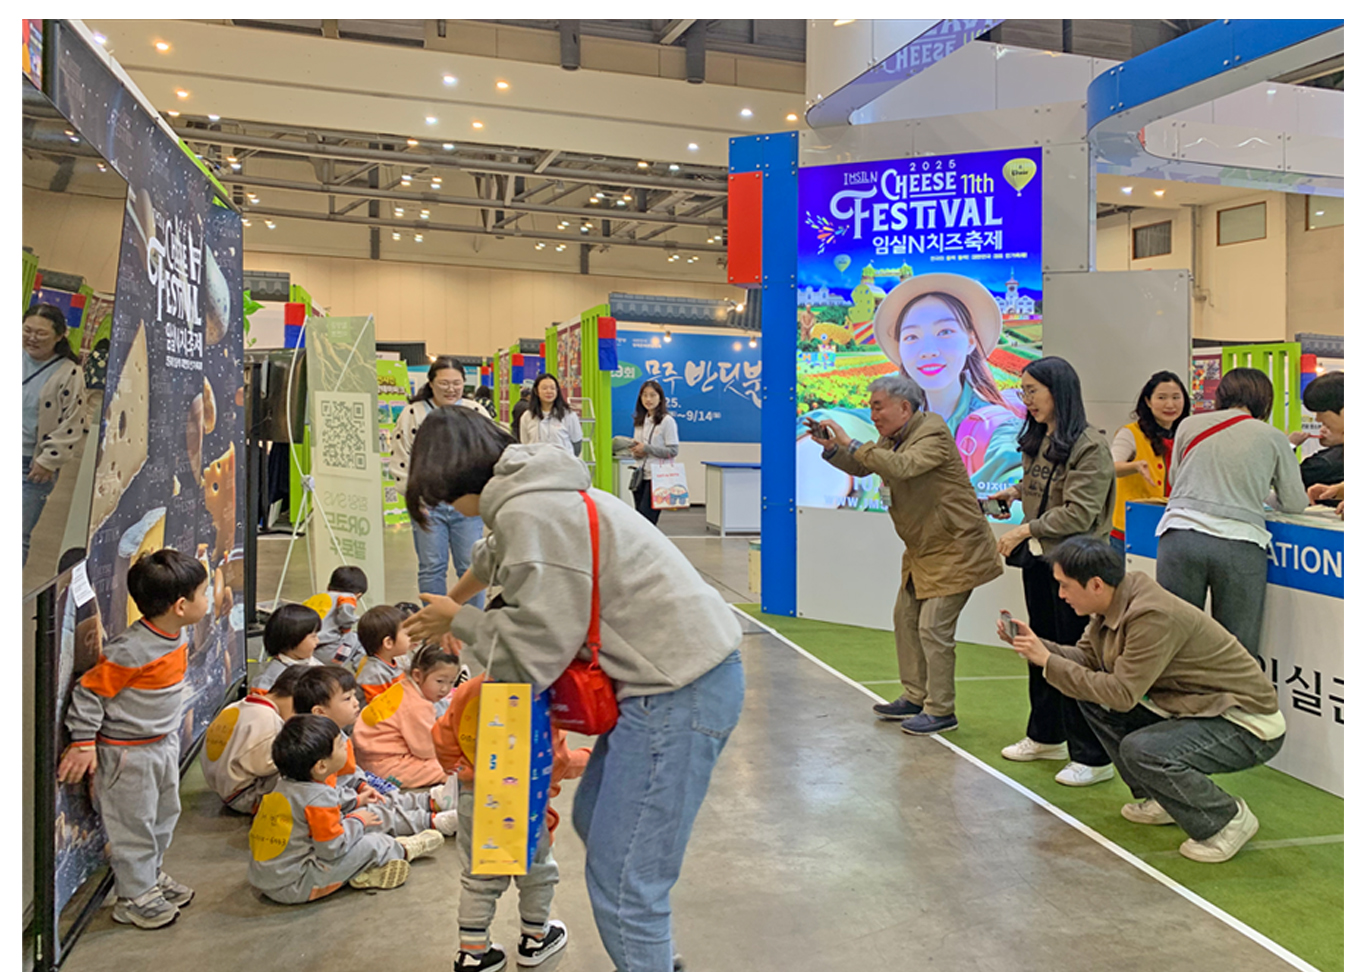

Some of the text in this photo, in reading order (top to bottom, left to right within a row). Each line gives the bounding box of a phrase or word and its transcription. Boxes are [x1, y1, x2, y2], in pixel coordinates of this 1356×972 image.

[909, 160, 957, 171] 2025
[881, 169, 956, 201] CHEESE
[961, 173, 994, 194] 11th
[830, 186, 1002, 239] FESTIVAL
[872, 230, 1003, 255] 임실N치즈축제
